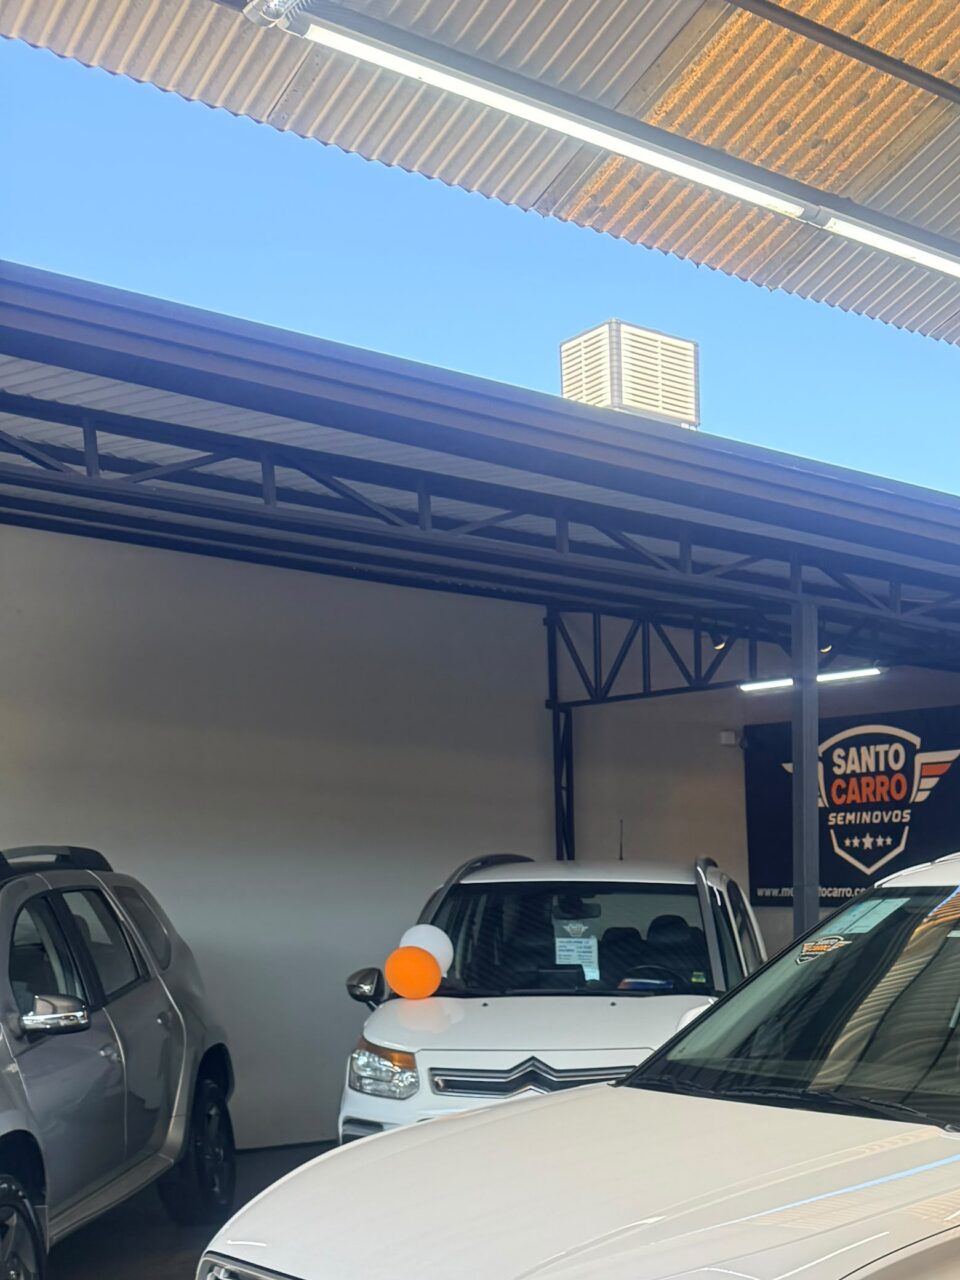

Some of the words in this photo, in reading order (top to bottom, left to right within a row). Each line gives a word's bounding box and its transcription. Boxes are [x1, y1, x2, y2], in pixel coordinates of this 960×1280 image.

[832, 743, 906, 775] SANTO
[831, 773, 907, 805] CARRO
[828, 809, 911, 825] SEMINOVOS
